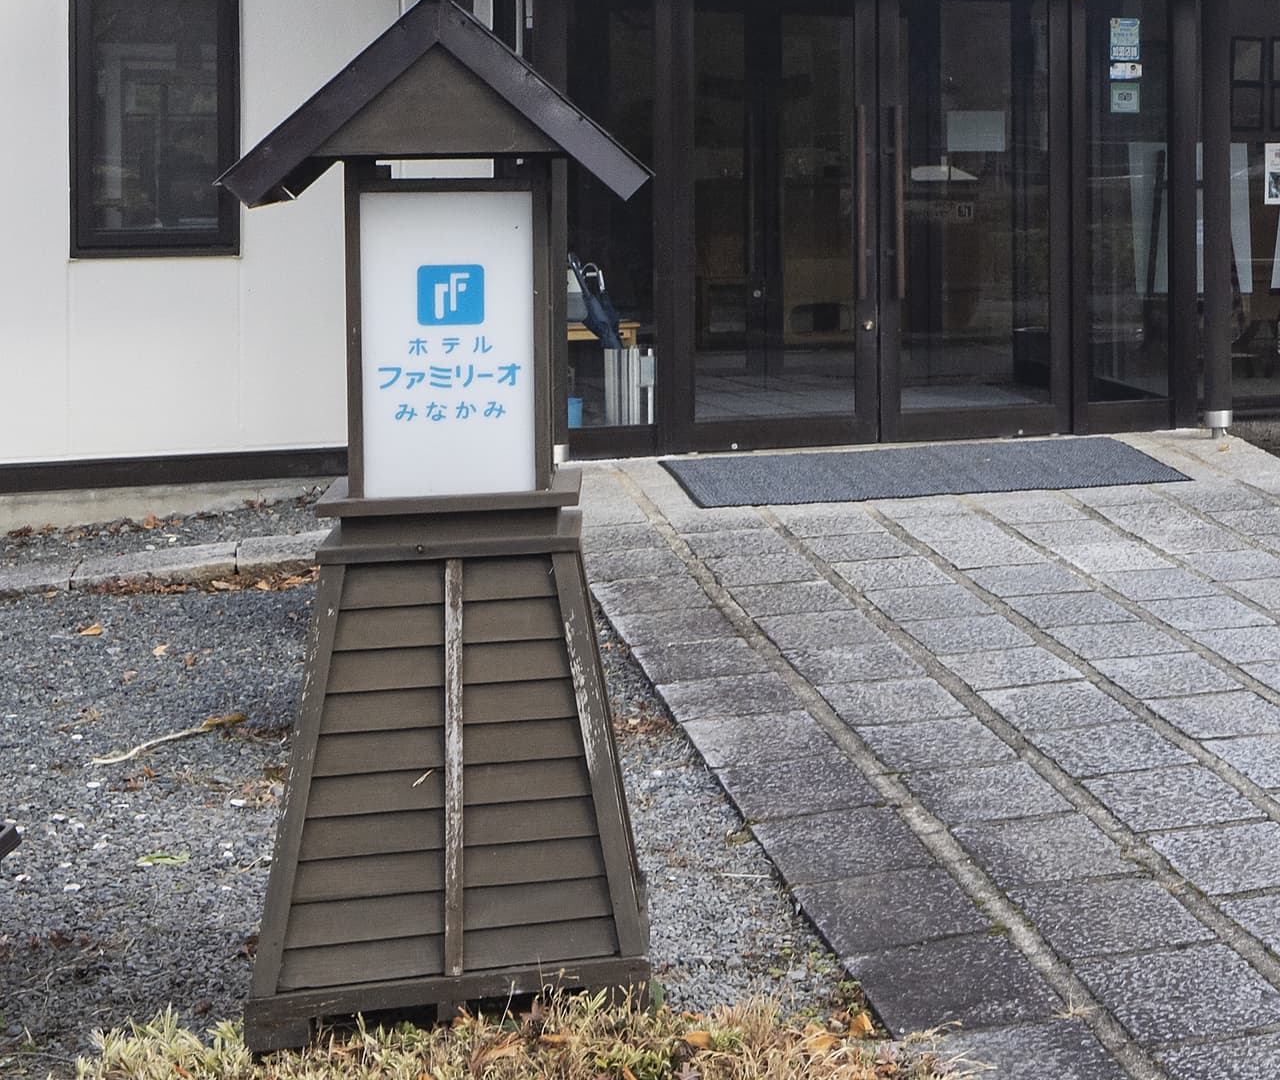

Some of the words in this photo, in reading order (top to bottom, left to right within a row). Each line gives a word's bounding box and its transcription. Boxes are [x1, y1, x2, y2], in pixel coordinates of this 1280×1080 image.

[408, 335, 493, 356] ホテル
[377, 363, 521, 389] ファミリーオ
[395, 401, 505, 422] みなかみ
